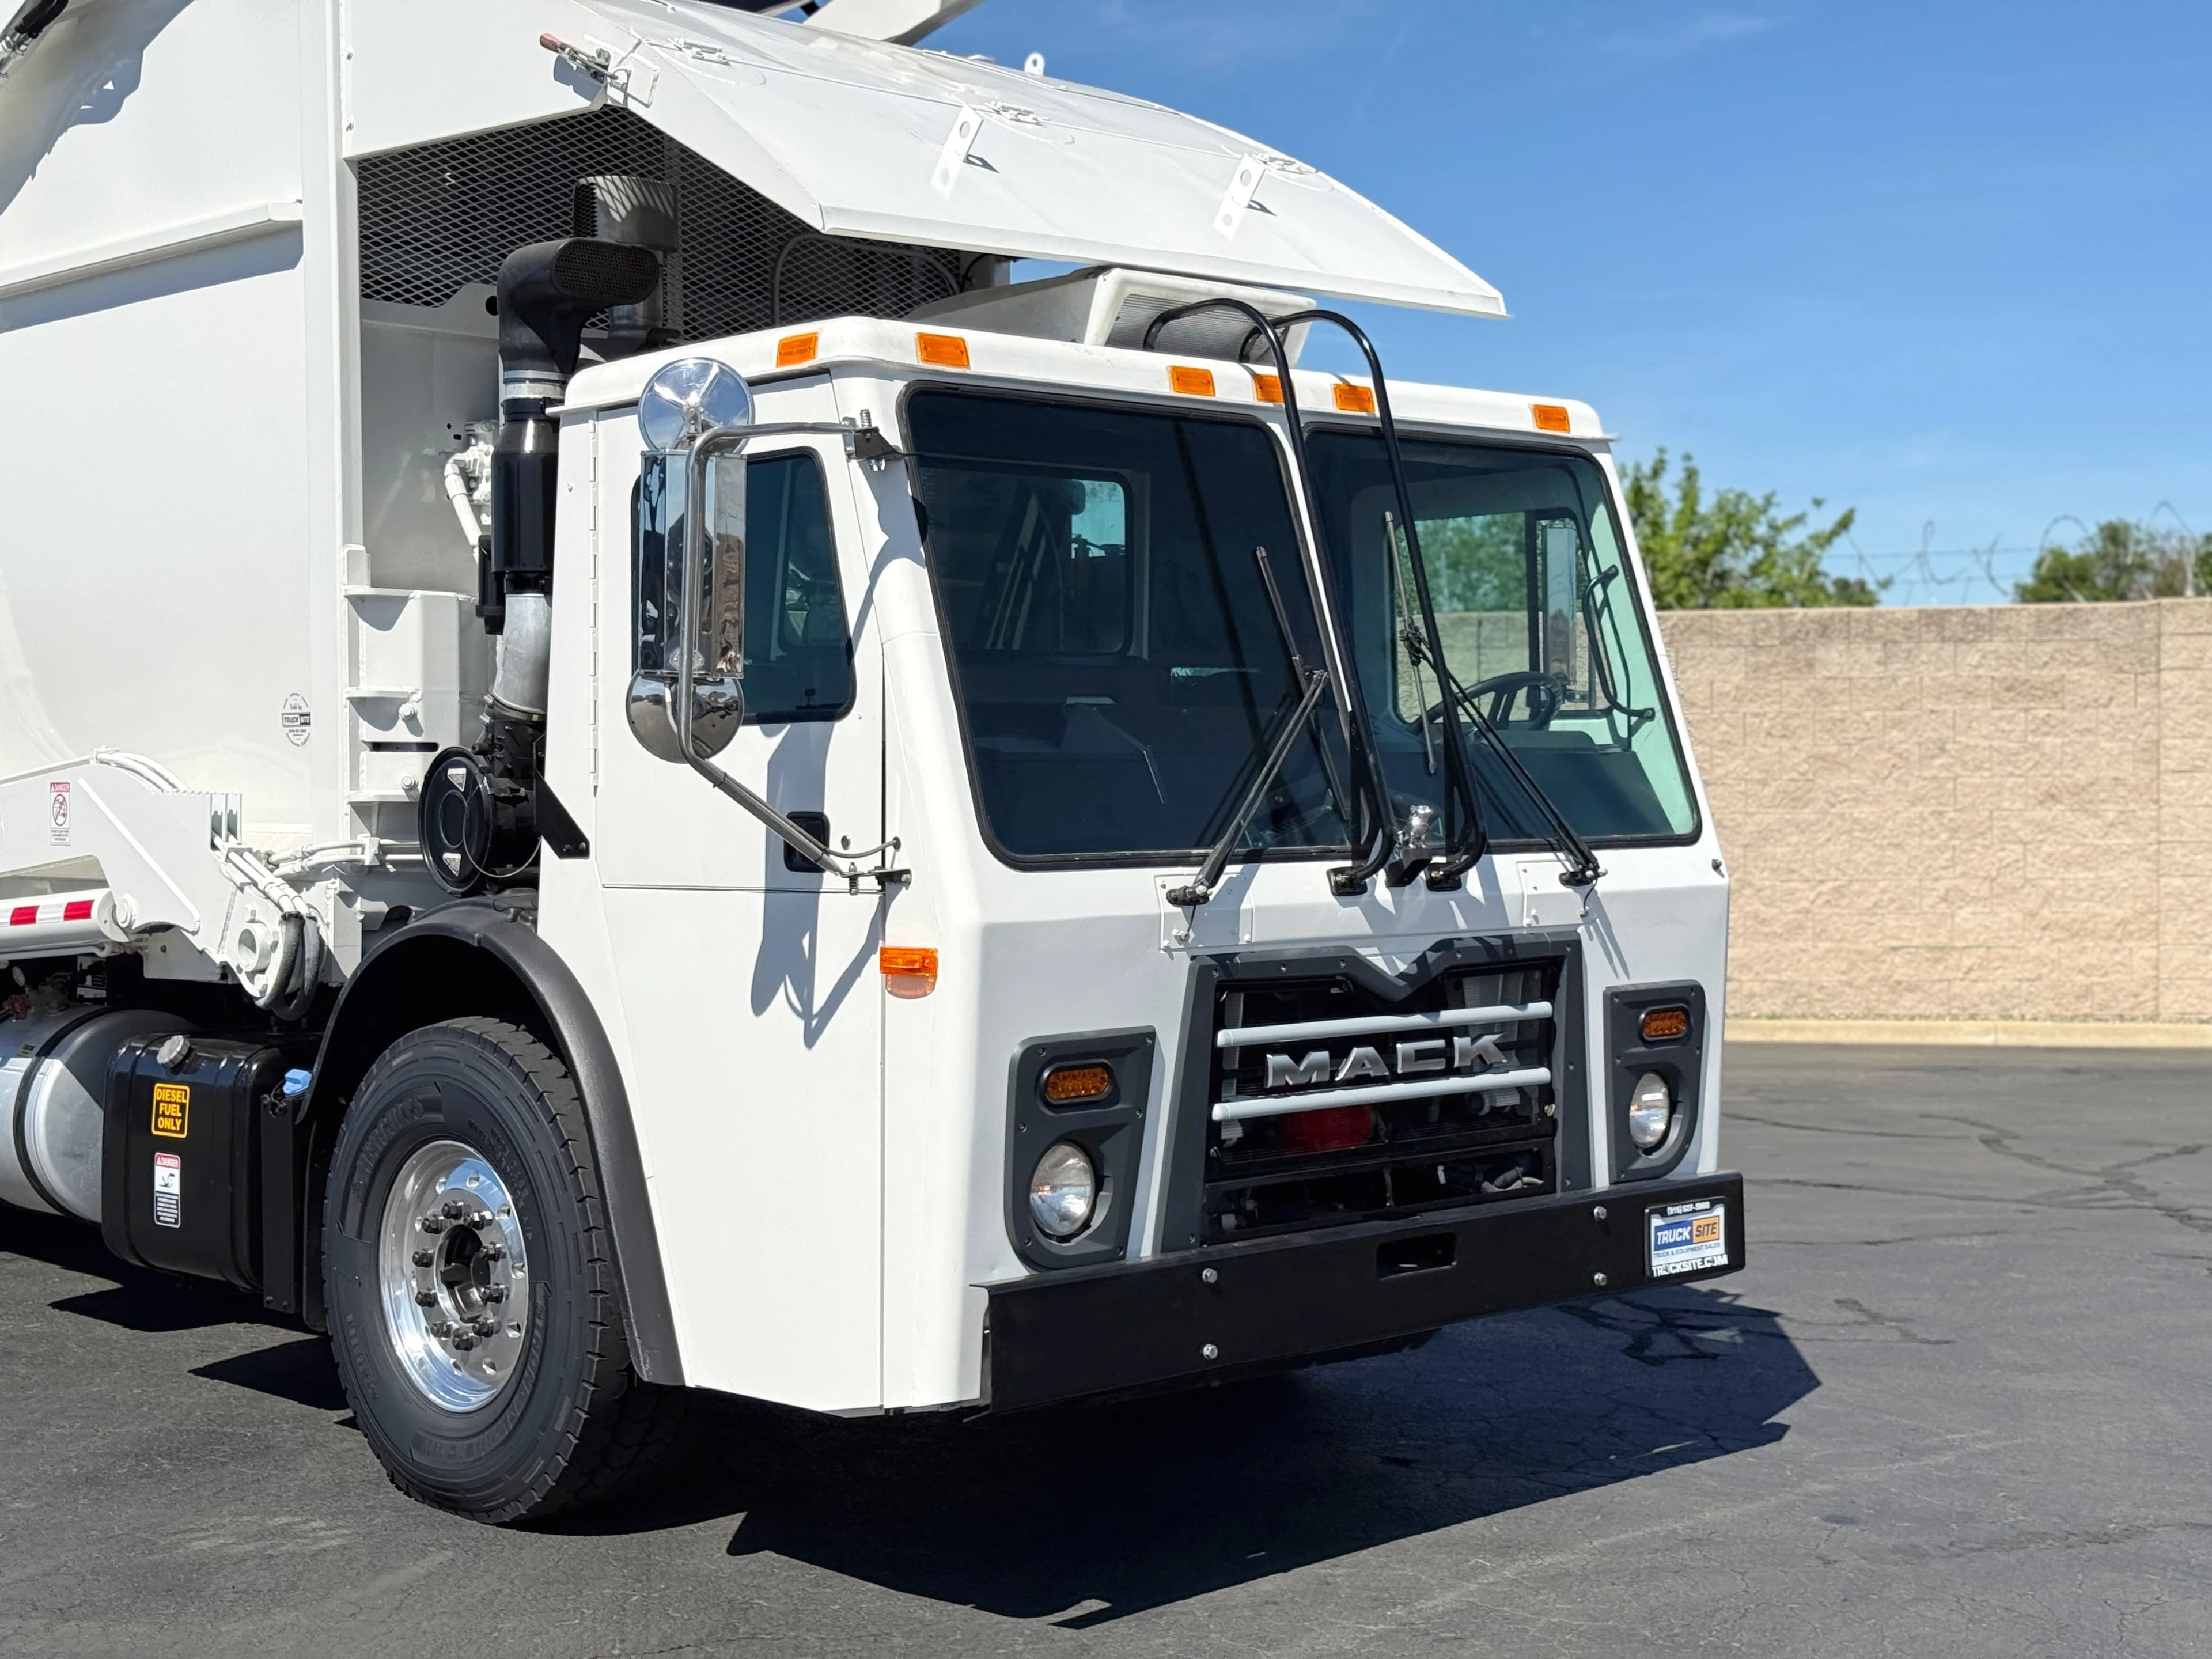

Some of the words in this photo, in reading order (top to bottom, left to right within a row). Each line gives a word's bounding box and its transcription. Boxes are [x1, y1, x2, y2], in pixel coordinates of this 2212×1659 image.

[1264, 1033, 1509, 1089] MACK
[156, 1088, 187, 1103] DIESEL
[159, 1103, 182, 1117] FUEL
[158, 1116, 182, 1131] ONLY
[1657, 1226, 1691, 1245] TRUCK
[1695, 1222, 1717, 1237] SITE
